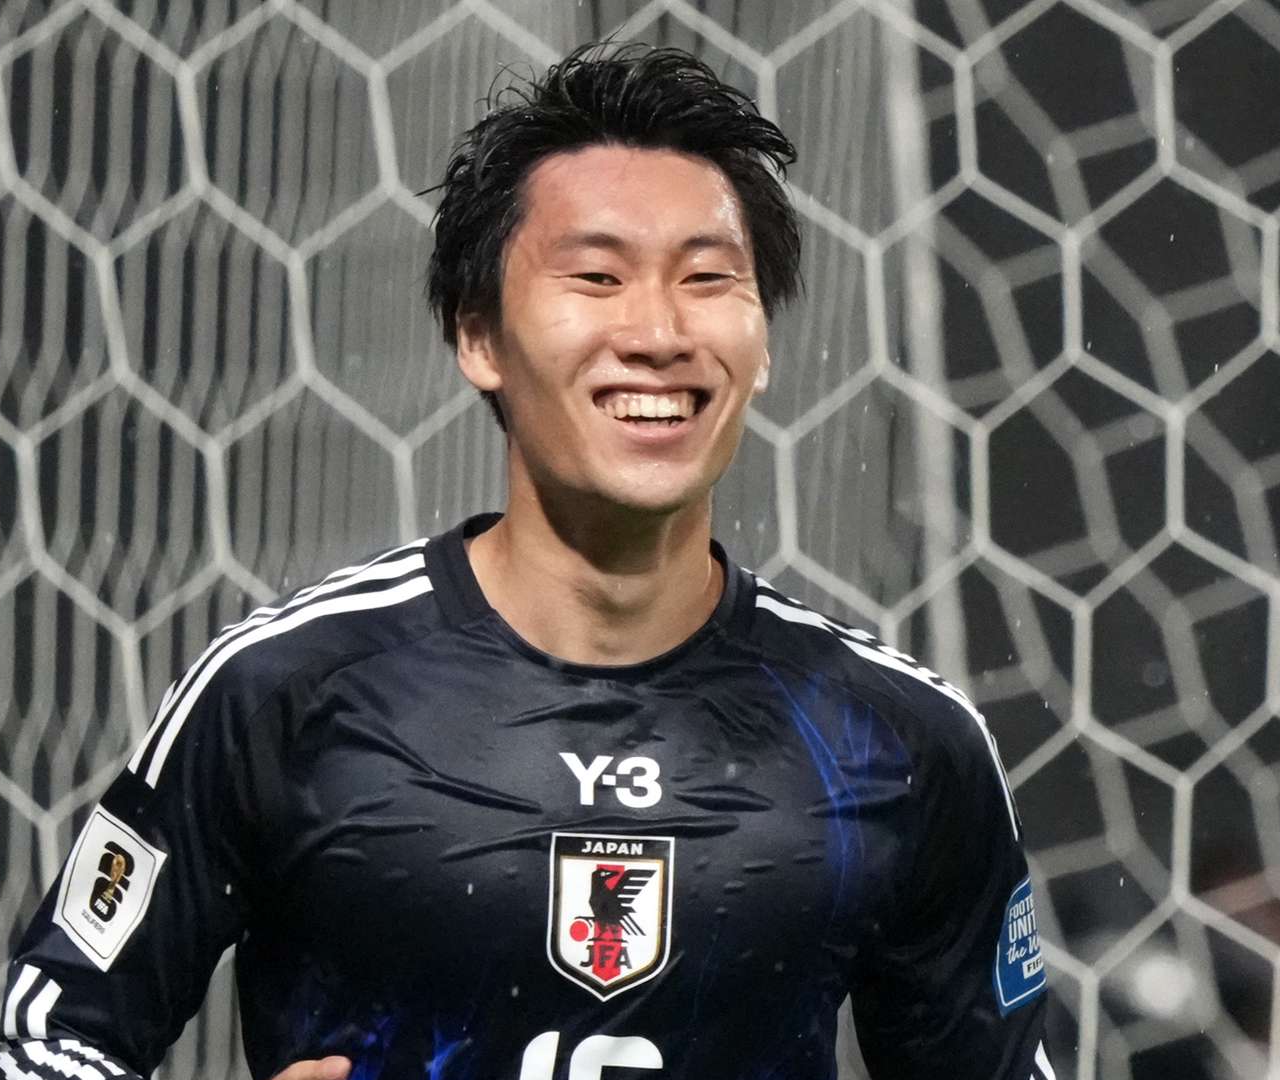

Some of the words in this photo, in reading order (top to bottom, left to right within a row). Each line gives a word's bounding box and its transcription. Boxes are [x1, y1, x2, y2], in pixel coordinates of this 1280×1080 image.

[559, 752, 662, 808] Y-3
[581, 841, 643, 855] JAPAN
[579, 944, 632, 969] JFA
